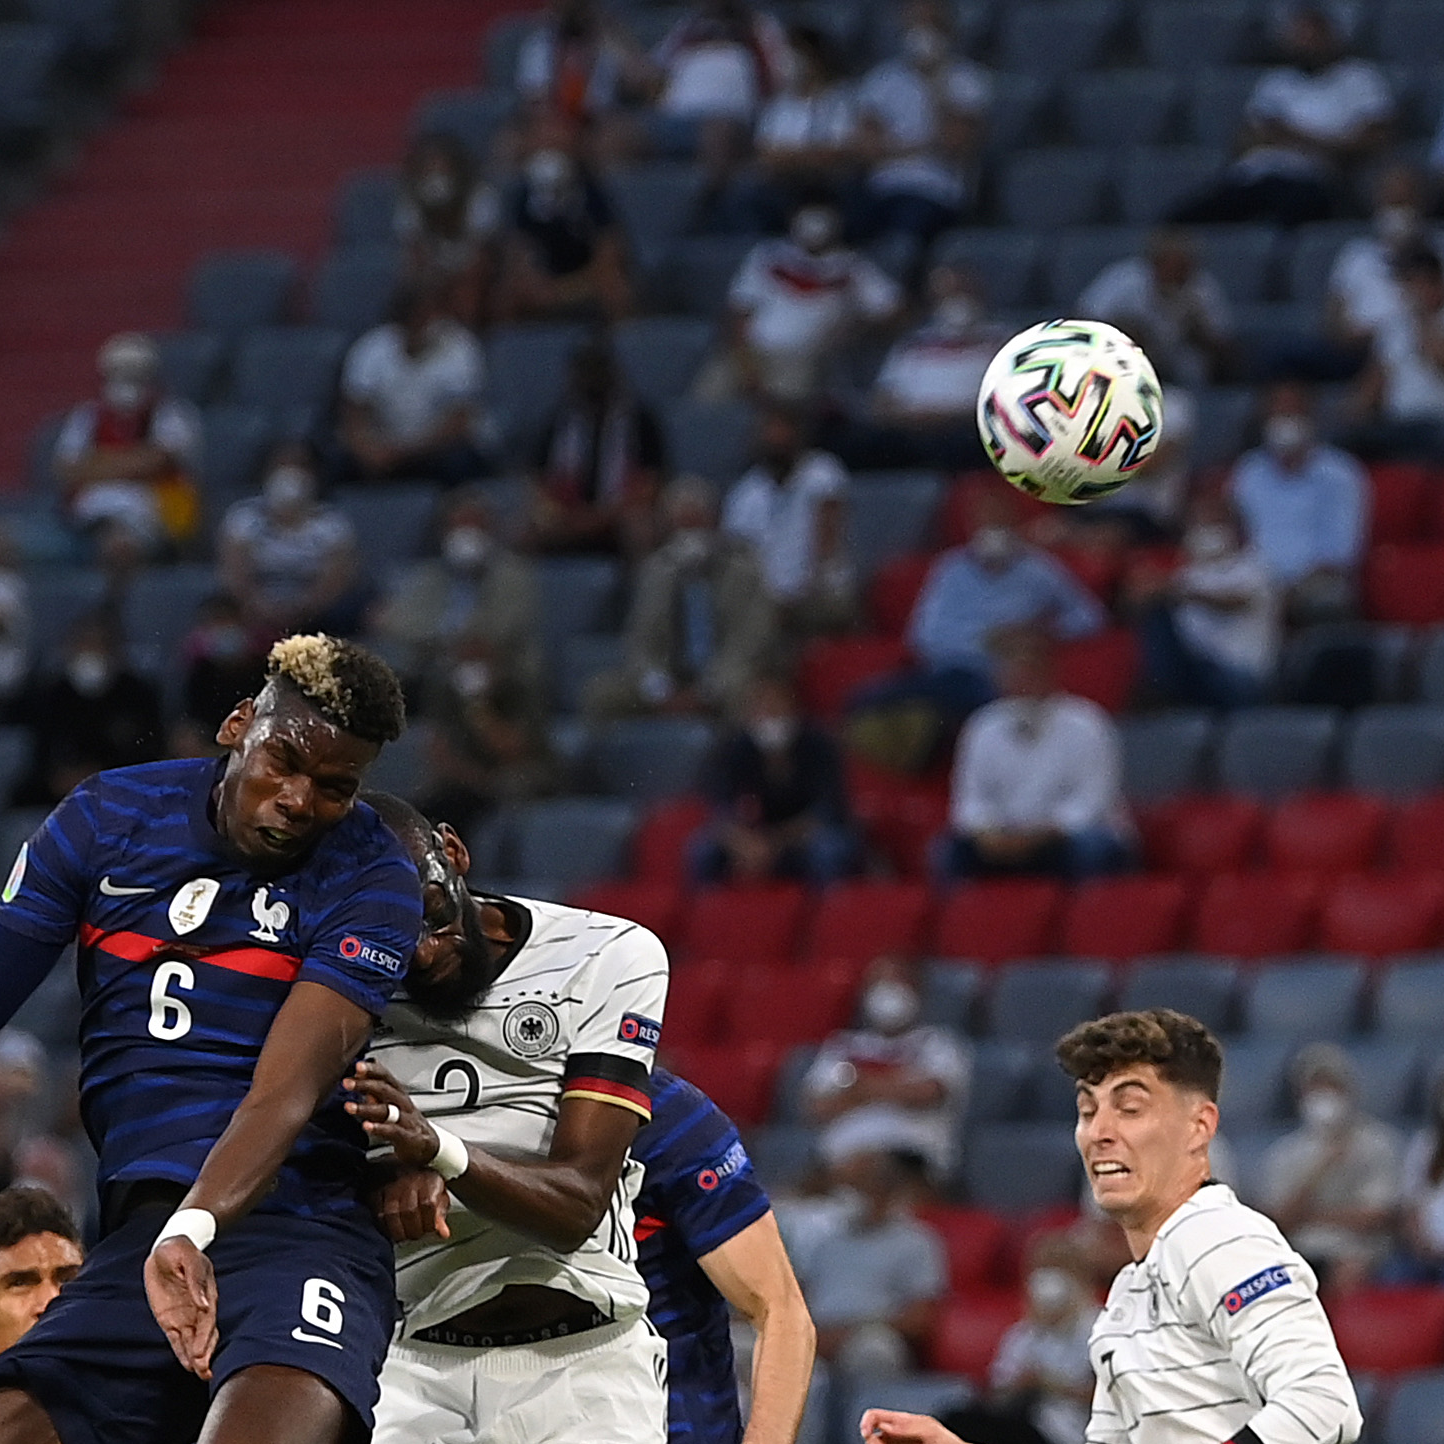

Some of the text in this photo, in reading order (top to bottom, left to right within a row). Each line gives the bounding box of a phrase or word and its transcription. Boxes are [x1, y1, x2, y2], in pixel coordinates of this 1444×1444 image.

[360, 946, 401, 972] RESPECT
[148, 961, 195, 1041] 6
[301, 1277, 346, 1335] 6
[428, 1328, 493, 1347] HUGO
